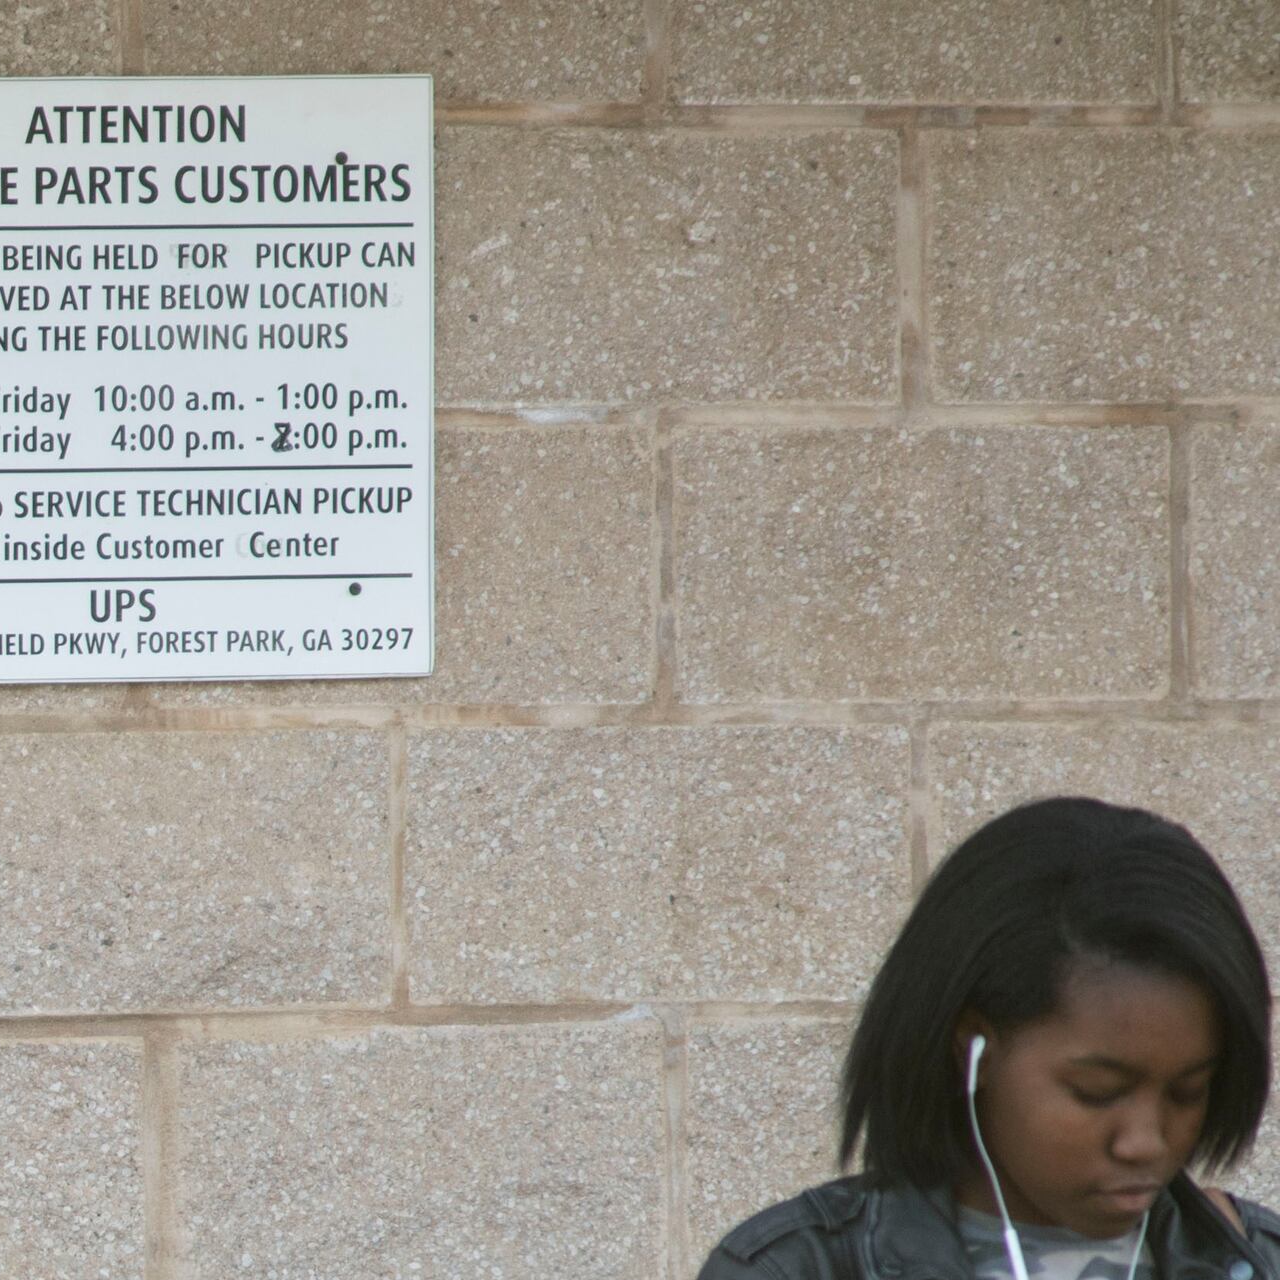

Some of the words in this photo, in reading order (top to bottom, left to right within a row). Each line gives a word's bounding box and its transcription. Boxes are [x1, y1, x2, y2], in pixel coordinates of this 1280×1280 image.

[25, 105, 245, 144] ATTENTION
[36, 166, 158, 204] PARTS
[175, 162, 411, 203] CUSTOMERS
[3, 245, 81, 270] BEING
[94, 245, 158, 270] HELD
[178, 244, 227, 268] FOR
[257, 243, 351, 268] PICKUP
[362, 242, 415, 267] CAN
[60, 285, 91, 310] AT
[102, 285, 149, 310] THE
[161, 284, 249, 309] BELOW
[260, 283, 388, 308] LOCATION
[38, 326, 86, 351] THE
[97, 324, 247, 350] FOLLOWING
[259, 323, 348, 349] HOURS
[95, 385, 174, 411] 10:00
[186, 392, 244, 412] a.m.
[278, 383, 337, 409] 1:00
[349, 390, 407, 416] p.m.
[111, 424, 174, 451] 4:00
[186, 431, 244, 457] p.m.
[349, 429, 407, 456] p.m.
[14, 491, 125, 518] SERVICE
[137, 488, 301, 516] TECHNICIAN
[314, 487, 413, 514] PICKUP
[4, 534, 85, 560] inside
[97, 533, 224, 559] Customer
[249, 532, 340, 558] Center
[90, 589, 156, 622] UPS
[53, 633, 127, 658] PKWY,
[137, 631, 218, 654] FOREST
[227, 630, 293, 656] PARK,
[302, 629, 333, 651] GA
[341, 627, 414, 651] 30297
